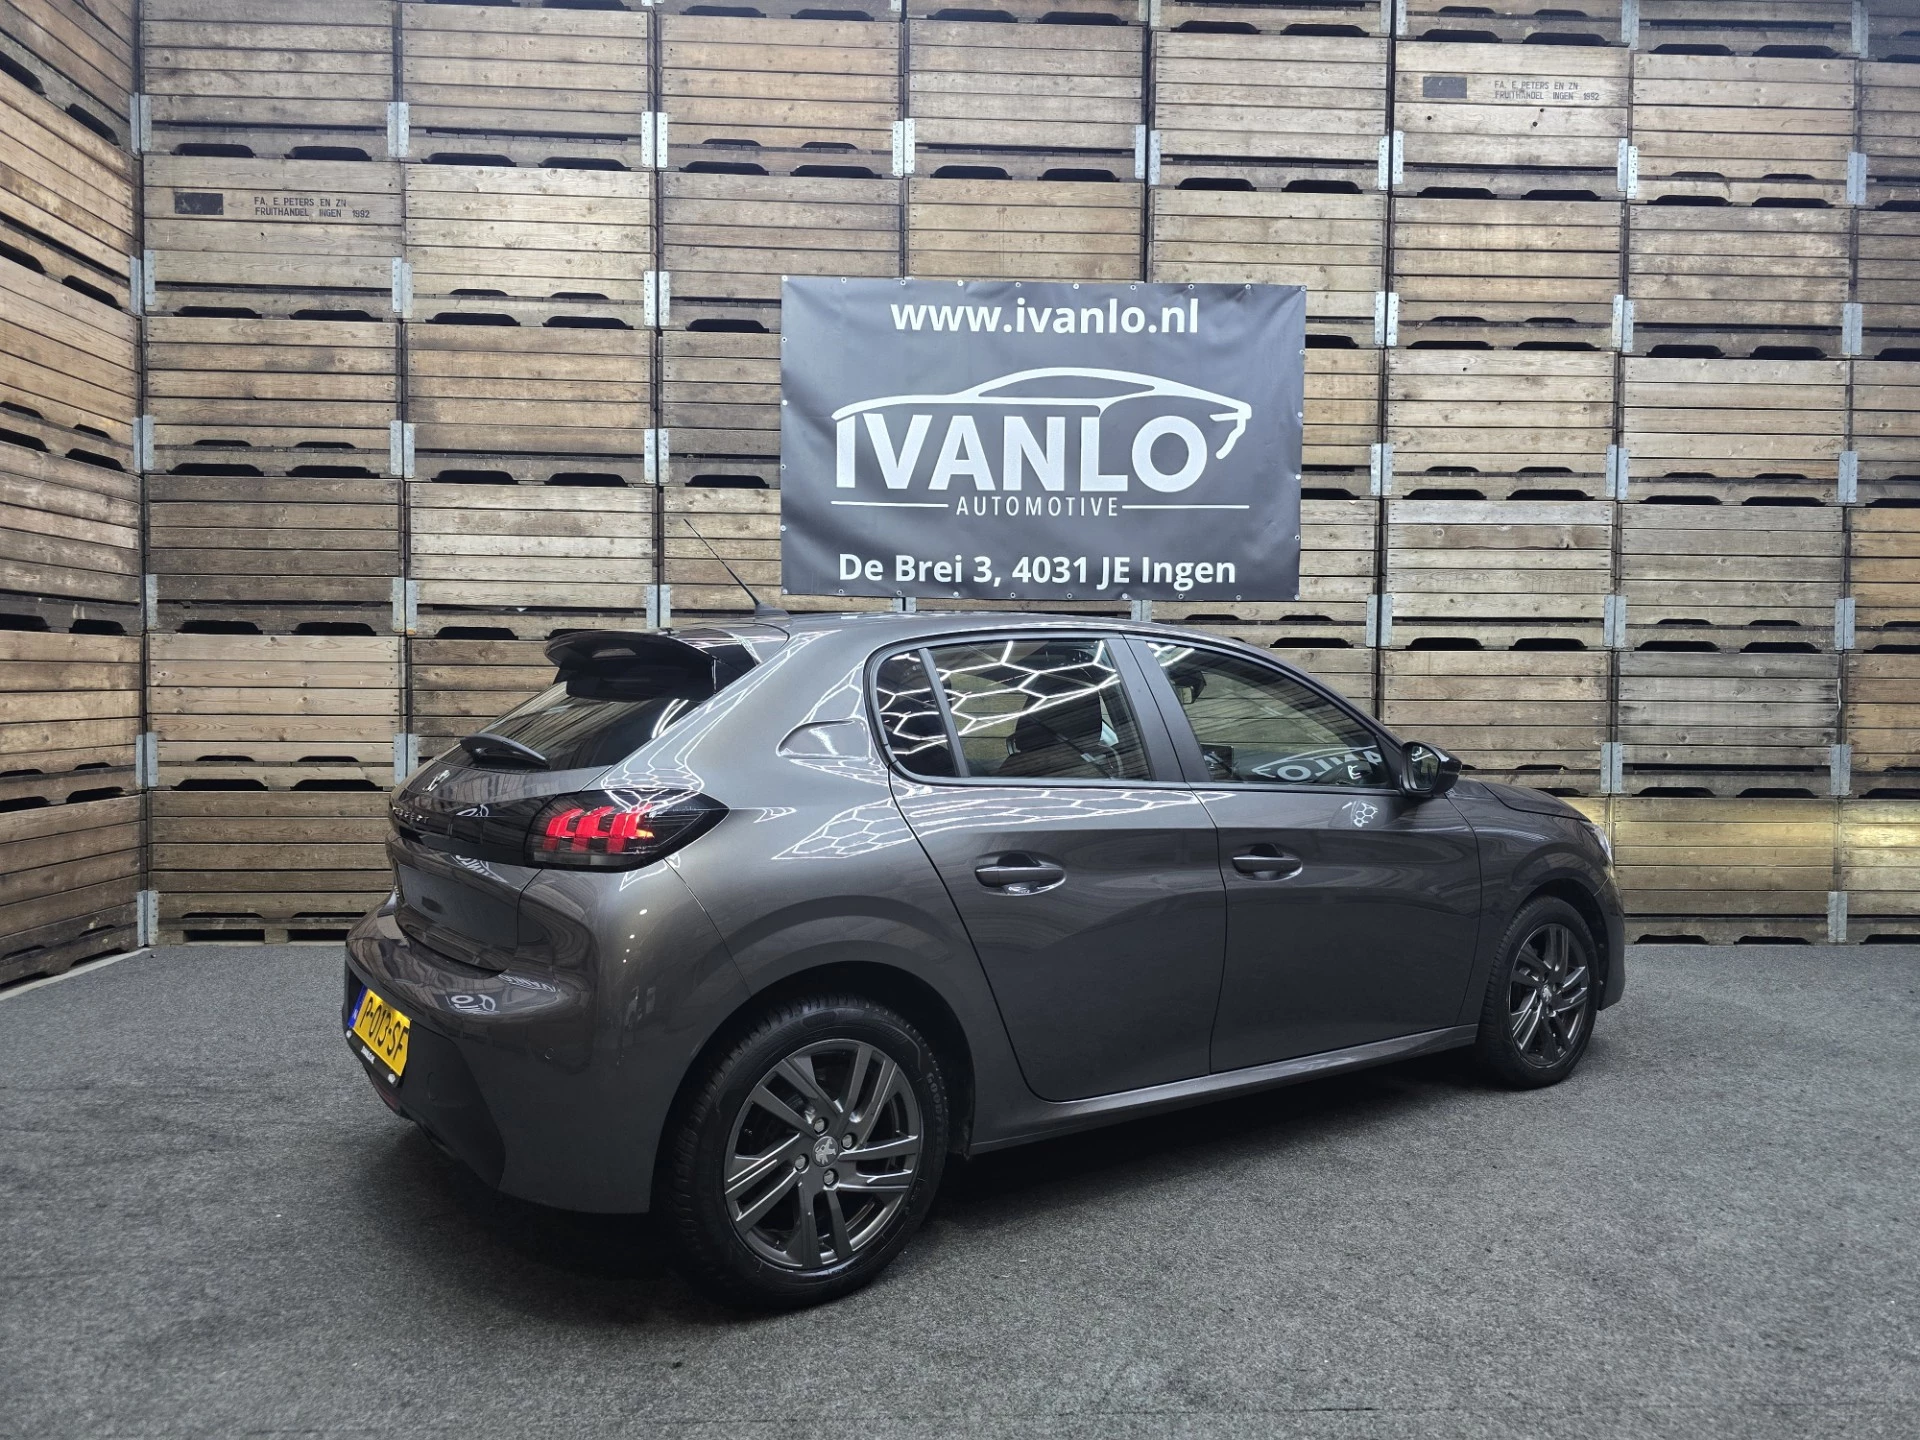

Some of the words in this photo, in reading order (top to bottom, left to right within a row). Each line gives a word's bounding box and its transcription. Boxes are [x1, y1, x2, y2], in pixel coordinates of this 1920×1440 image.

[1520, 81, 1550, 90] PETERS
[1554, 82, 1565, 90] EN
[1568, 82, 1579, 90] ZN
[1552, 91, 1574, 100] INGEN
[1582, 92, 1600, 101] 1992
[254, 206, 310, 217] FRUITHANDEL
[318, 208, 342, 218] INGEN
[352, 209, 370, 218] 1992
[283, 197, 315, 207] PETERS
[320, 198, 331, 207] EN
[335, 198, 347, 207] ZN
[890, 297, 1199, 334] www.ivanlo.nl
[836, 413, 1208, 493] IVANLO
[956, 496, 1118, 517] AUTOMOTIVE
[839, 553, 884, 581] De
[895, 554, 963, 583] Brei
[973, 555, 1001, 587] 3,
[1011, 556, 1088, 584] 4031
[1096, 556, 1130, 590] JE
[1142, 556, 1236, 590] Ingen
[359, 996, 409, 1060] P-013-SF
